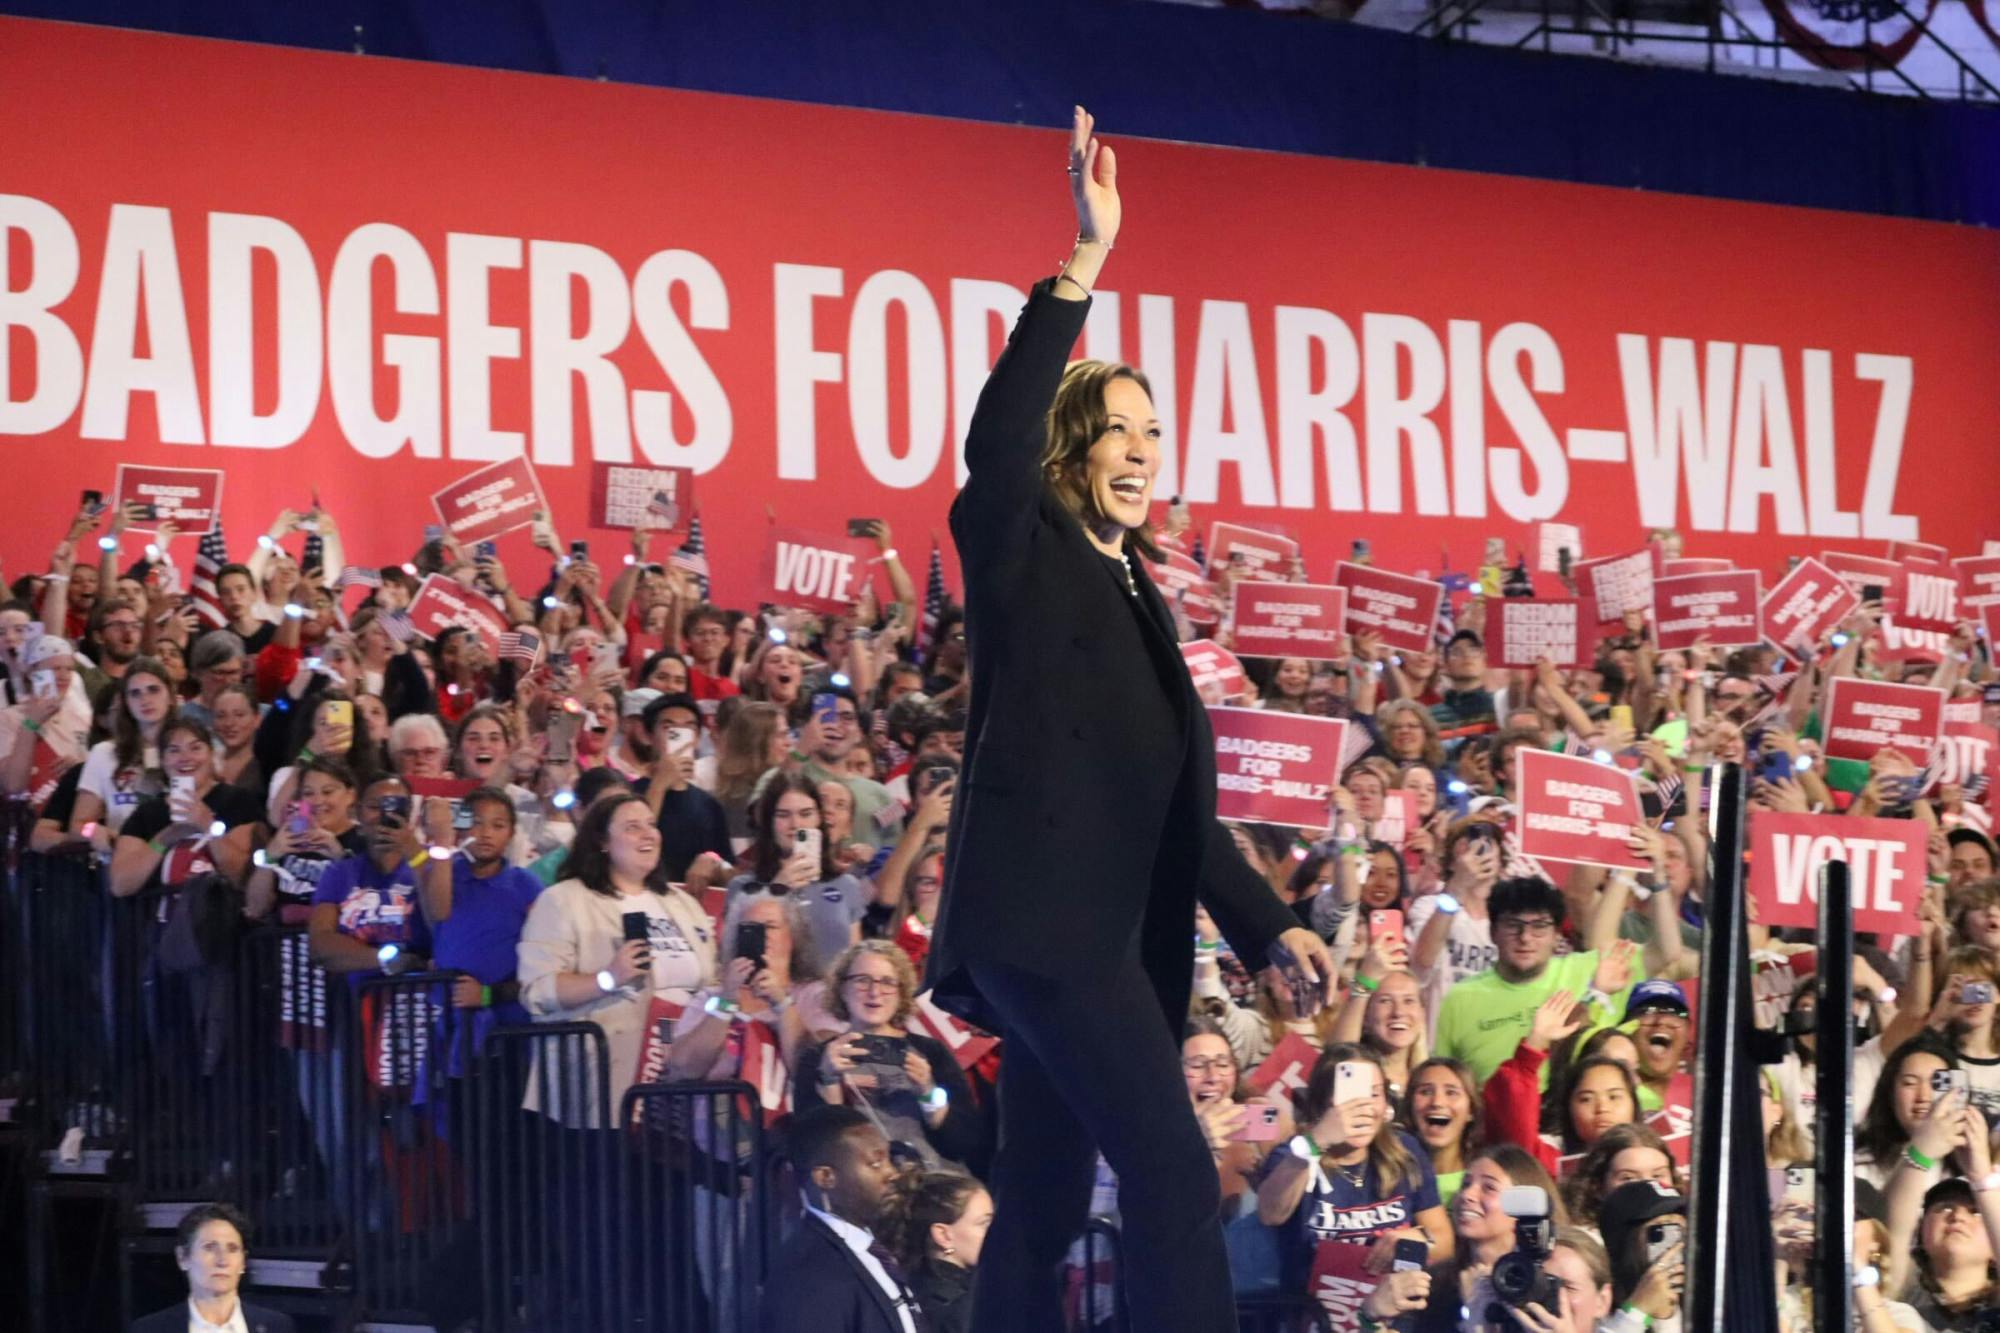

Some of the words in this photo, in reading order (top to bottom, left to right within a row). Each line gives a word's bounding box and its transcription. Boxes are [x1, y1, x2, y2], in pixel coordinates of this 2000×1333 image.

[0, 193, 734, 476] BADGERS
[774, 541, 855, 603] VOTE
[1216, 735, 1313, 763] BADGERS
[1239, 757, 1283, 777] FOR
[1216, 772, 1330, 801] RRIS-WALZ
[1544, 779, 1623, 806] BADGERS
[1567, 799, 1605, 820] FOR
[1525, 812, 1642, 841] HARRIS-WAL
[1307, 1199, 1406, 1231] HARRIS
